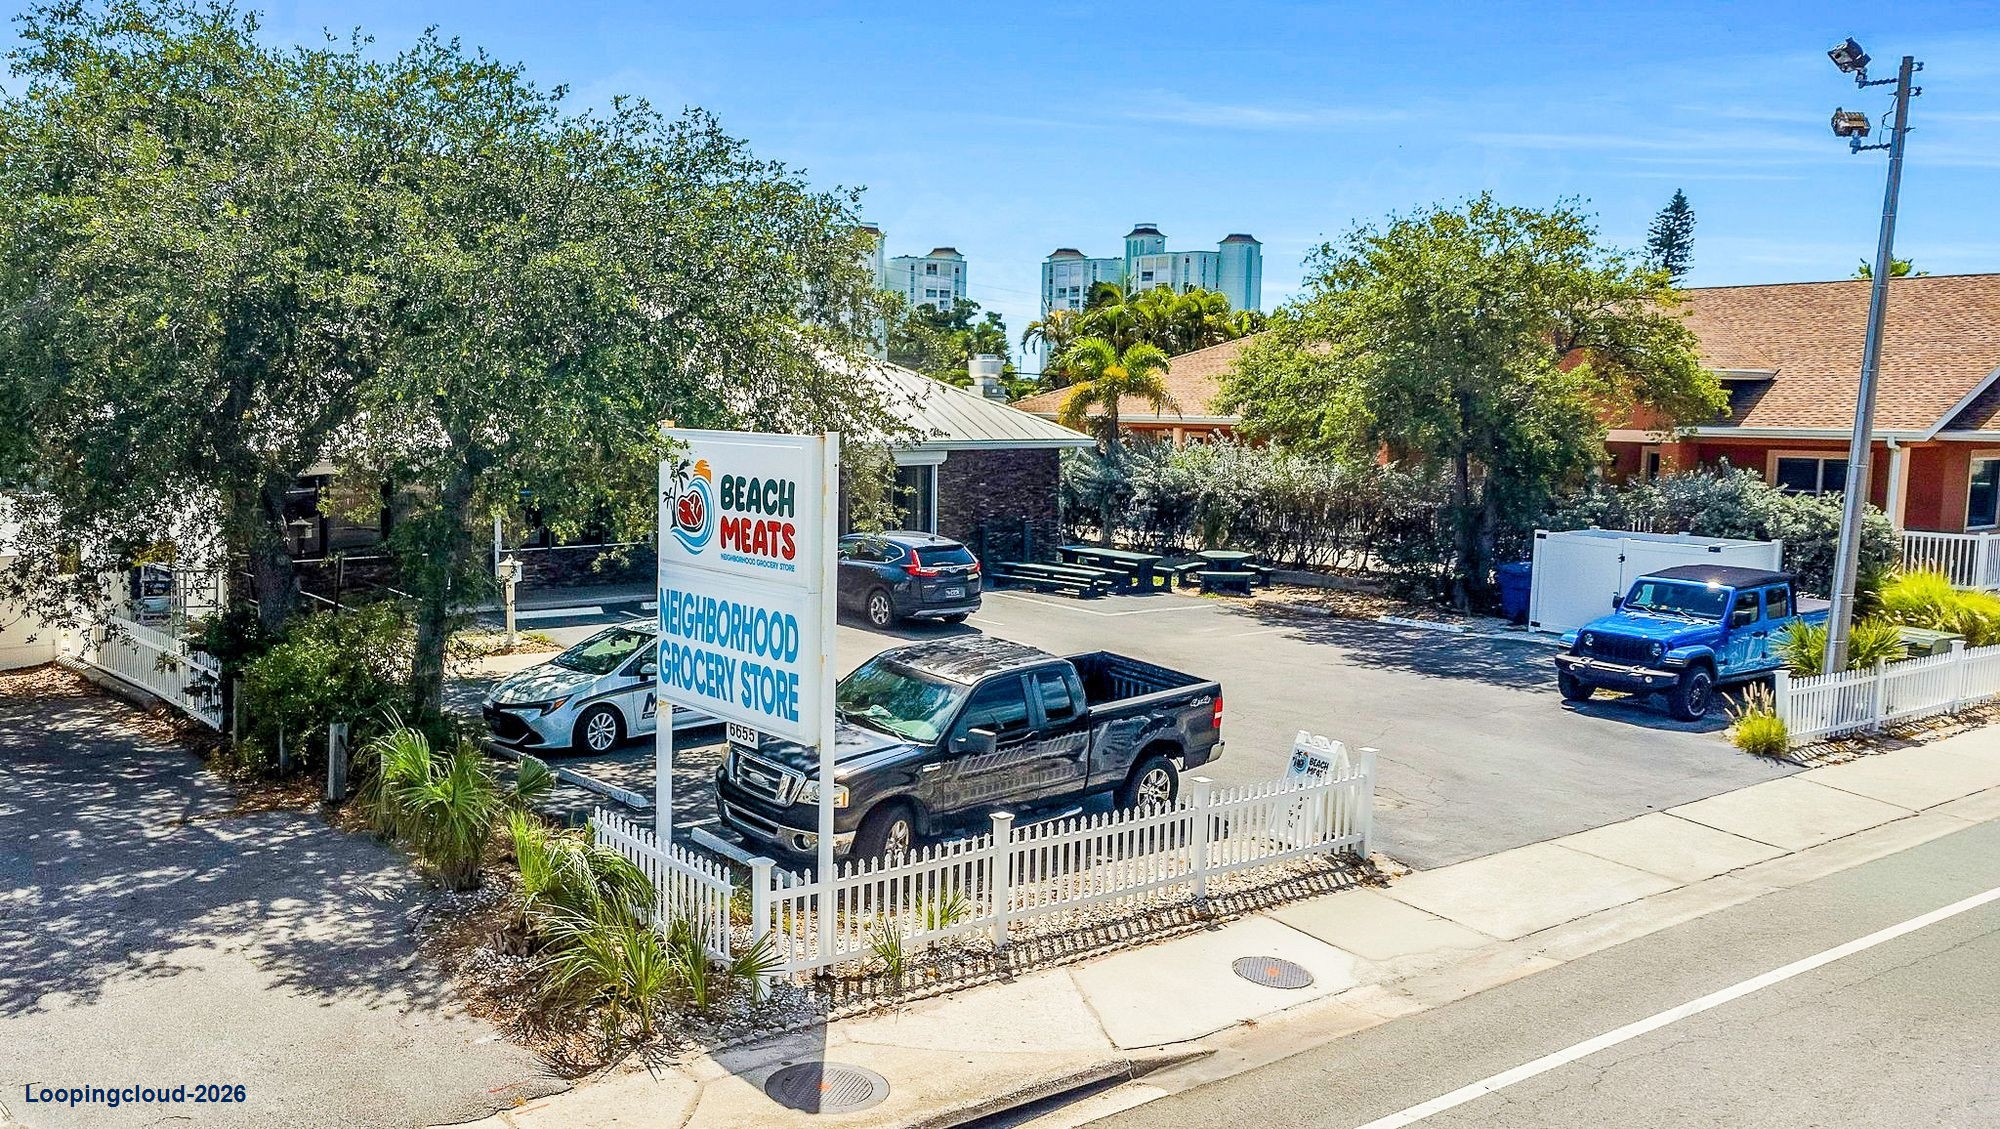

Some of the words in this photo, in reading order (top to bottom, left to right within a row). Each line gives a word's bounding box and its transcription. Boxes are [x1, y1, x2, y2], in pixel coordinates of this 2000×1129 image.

[720, 474, 795, 518] BEACH
[720, 515, 796, 561] MEATS
[720, 553, 756, 566] NEIGHBORHOOD
[756, 558, 779, 570] GROCERY
[779, 563, 795, 572] STORE
[659, 588, 799, 664] NEIGHBORHOOD
[659, 639, 736, 703] GROCERY
[741, 660, 799, 723] STORE
[729, 722, 755, 743] 6655
[1306, 766, 1327, 778] MEA
[1309, 757, 1330, 771] BEACH
